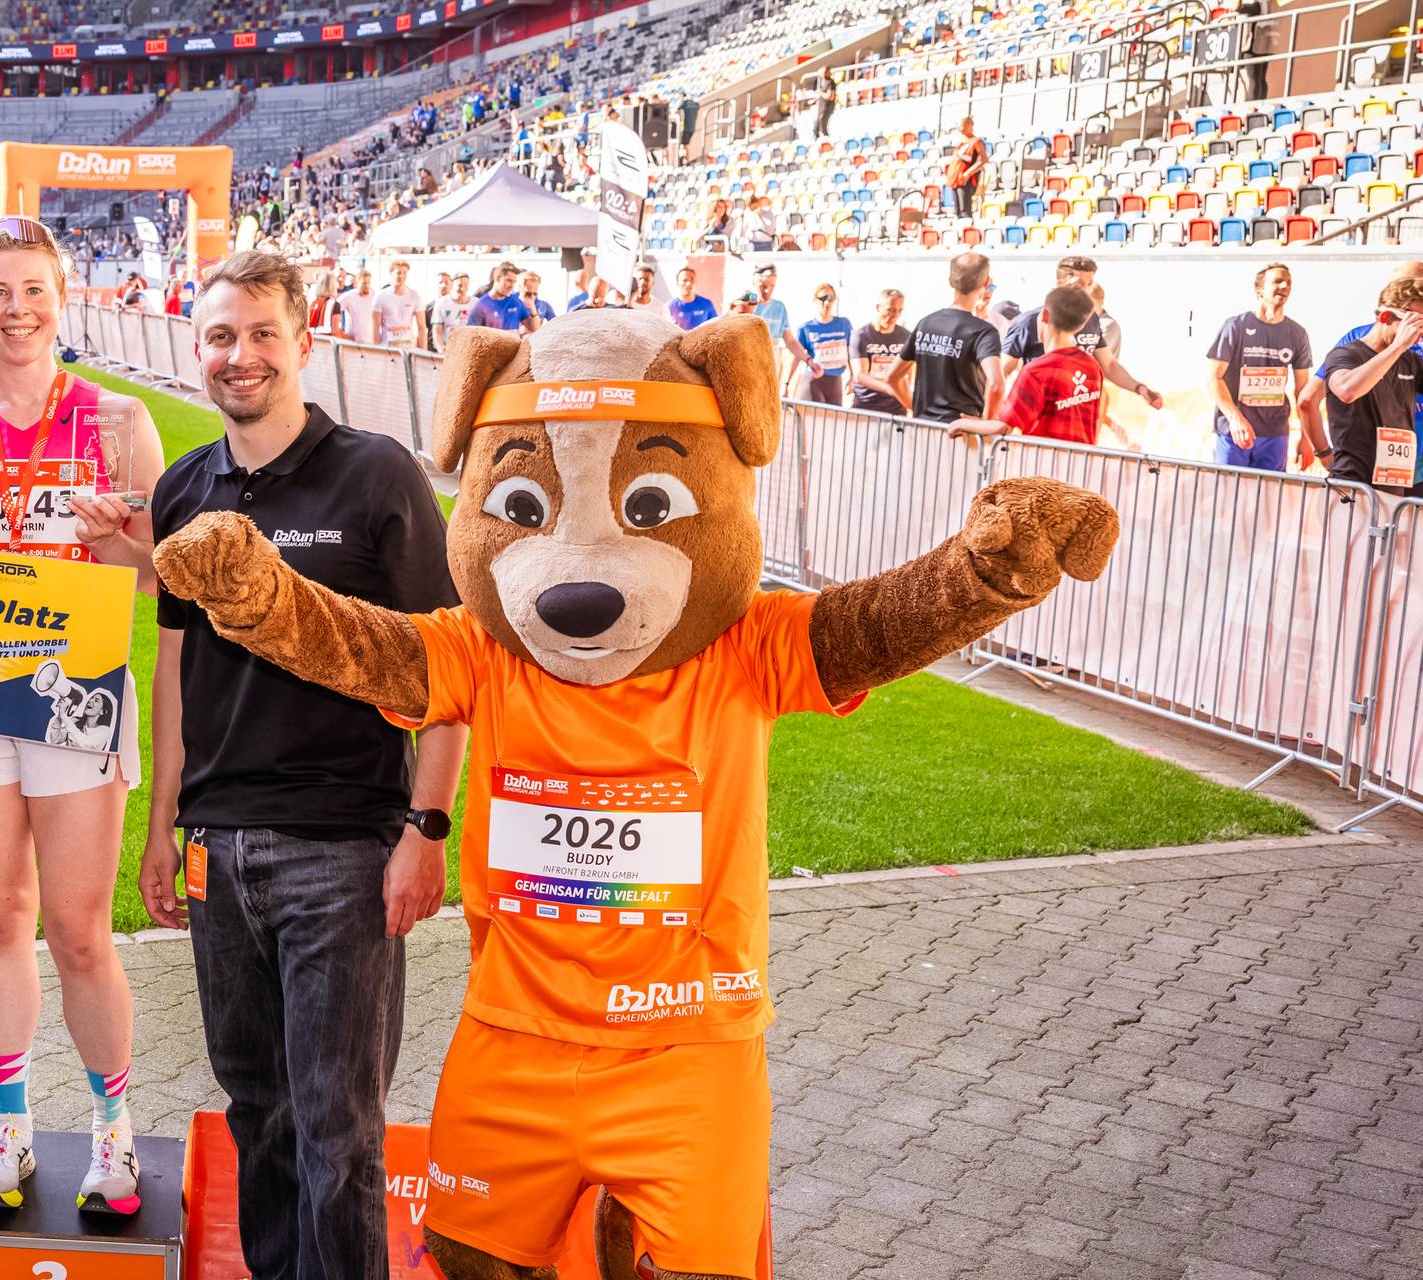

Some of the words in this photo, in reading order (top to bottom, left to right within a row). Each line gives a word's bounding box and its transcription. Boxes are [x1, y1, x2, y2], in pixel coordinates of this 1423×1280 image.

[1205, 31, 1231, 61] 30
[1079, 52, 1102, 81] 29
[1247, 378, 1282, 387] 12708
[1387, 443, 1413, 459] 940
[1, 523, 45, 531] KAHRIN
[272, 529, 314, 542] B2Run
[72, 547, 82, 559] D
[30, 638, 68, 647] VORBEI
[19, 649, 40, 658] UND
[42, 648, 56, 658] 2)!
[504, 773, 543, 791] B2Run
[540, 813, 642, 851] 2026
[567, 852, 614, 866] BUDDY
[543, 865, 578, 876] INFRONT
[580, 869, 610, 879] B2RUN
[612, 871, 639, 880] GMBH
[514, 879, 584, 899] GEMEINSAM
[586, 886, 611, 901] FÜR
[613, 889, 671, 903] VIELFALT
[712, 969, 762, 990] DAK
[606, 980, 705, 1013] B2Run
[674, 1004, 705, 1017] AKTIV
[461, 1175, 490, 1194] DAK
